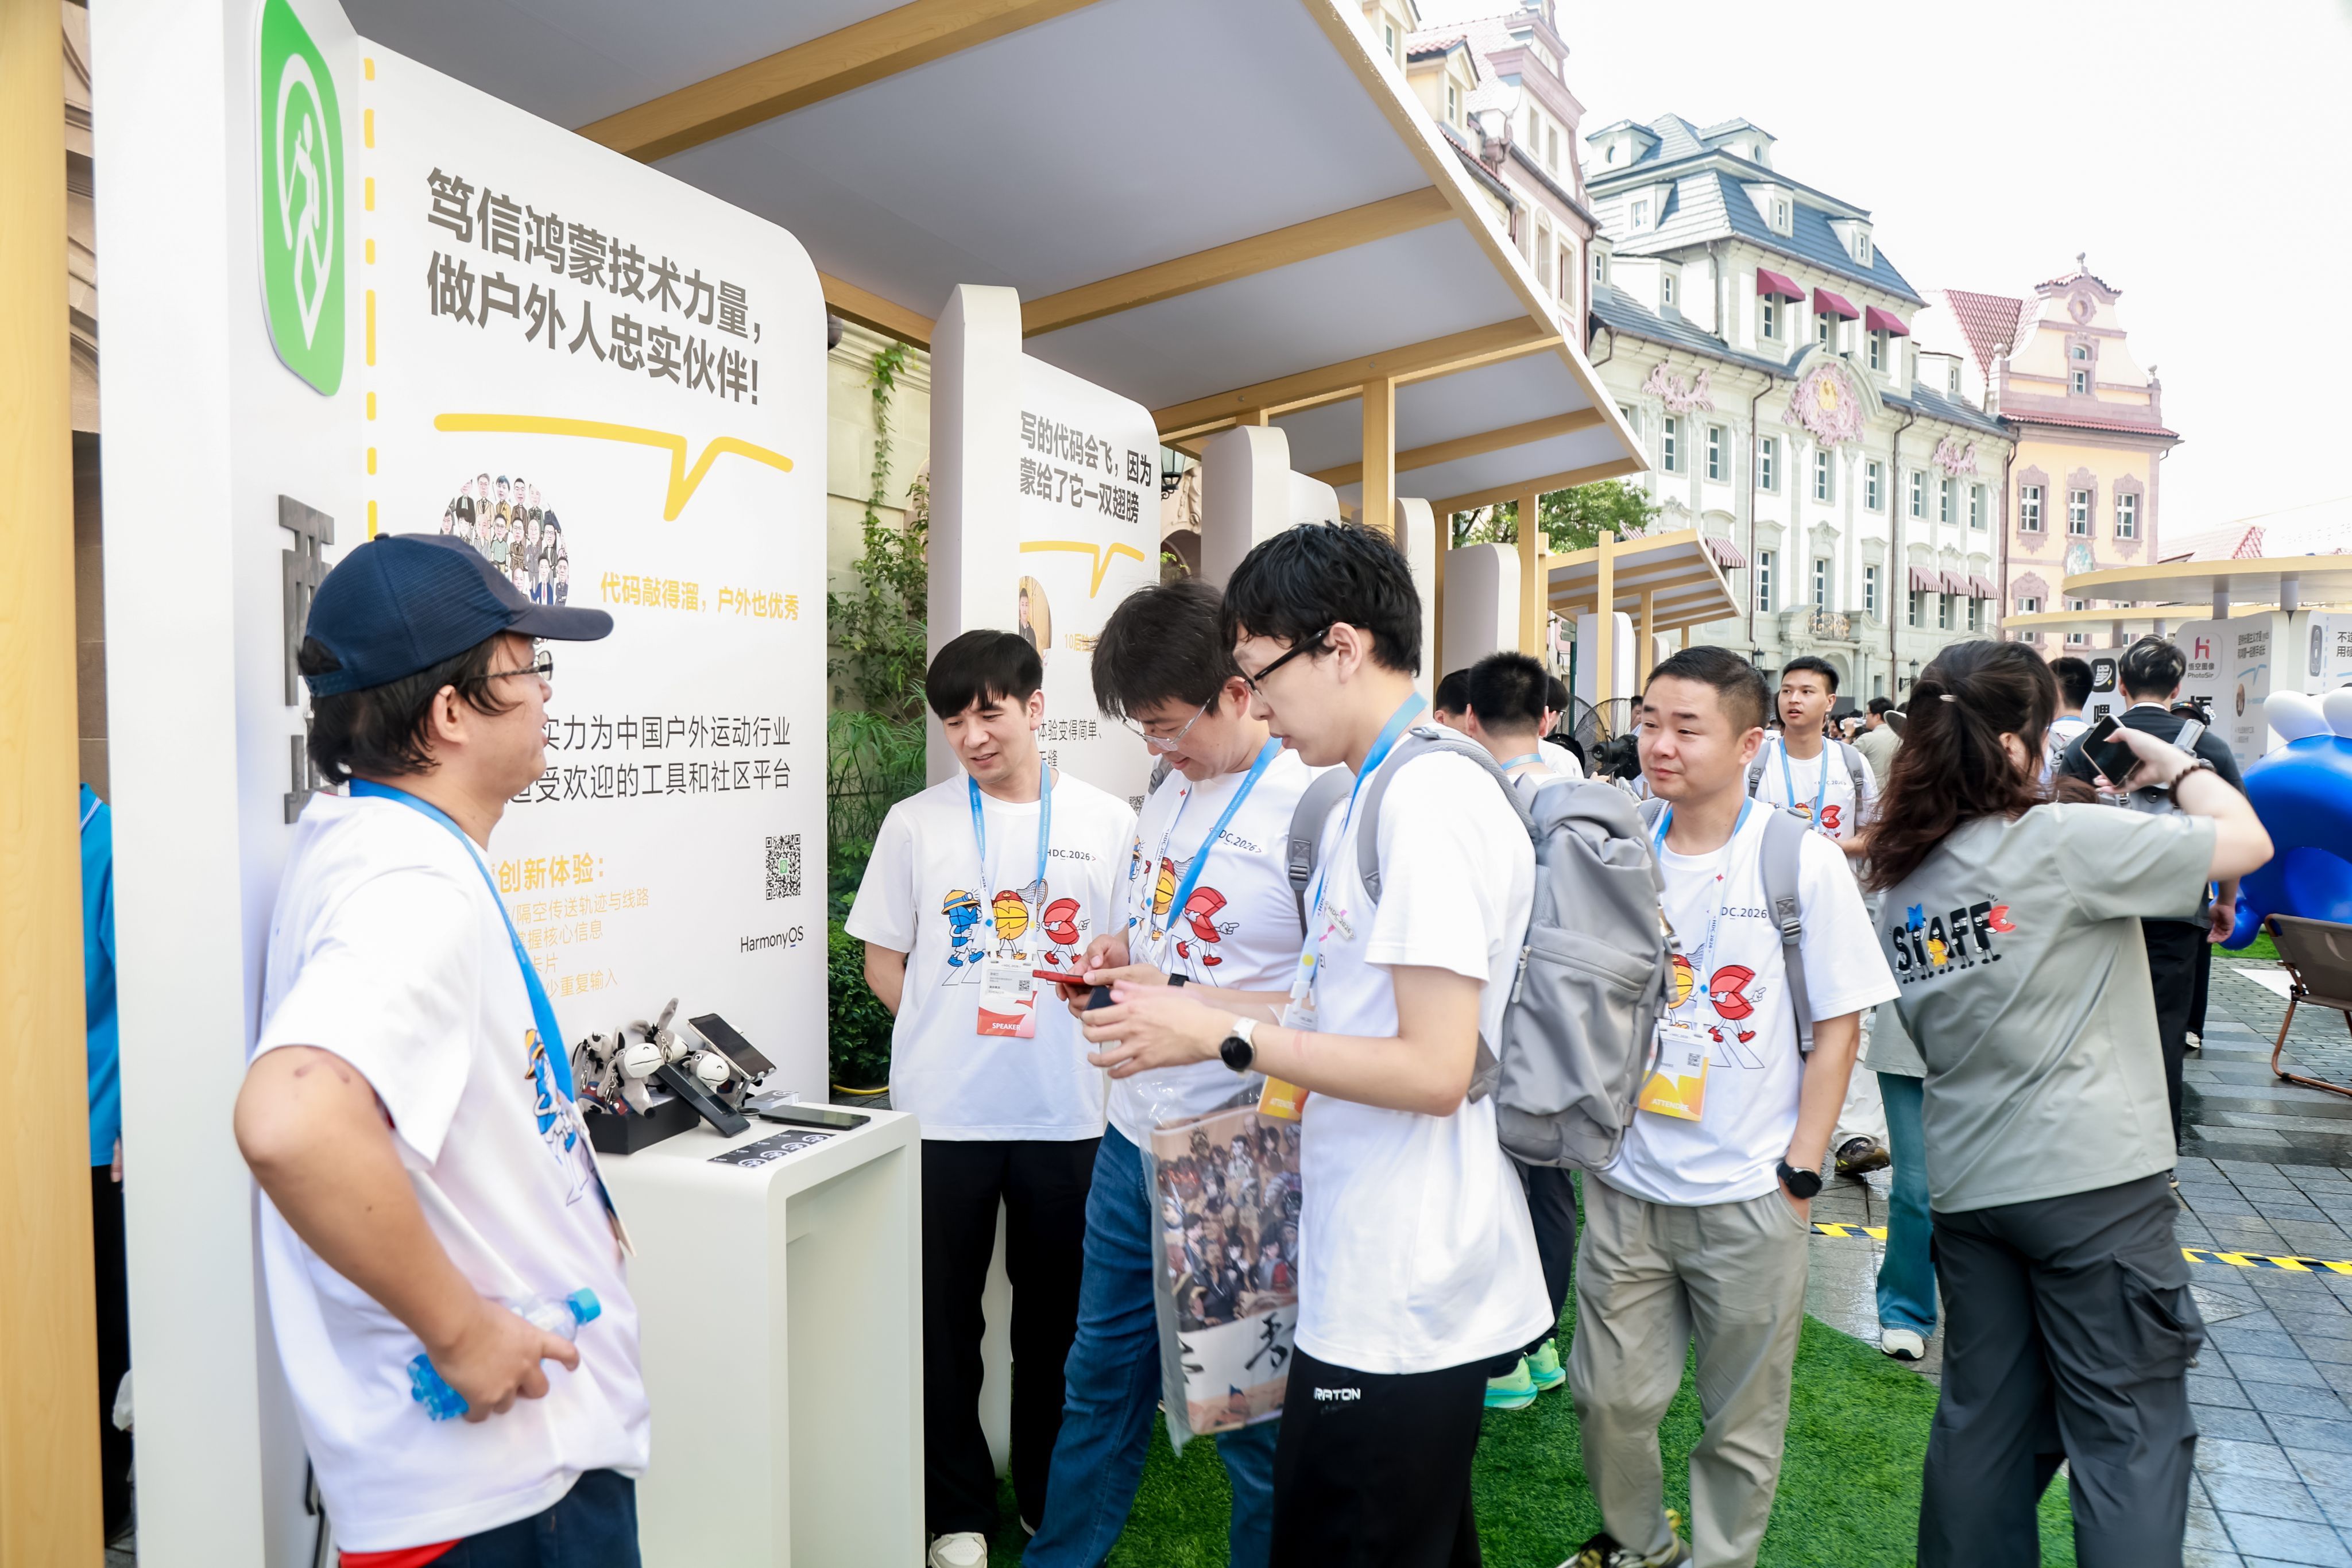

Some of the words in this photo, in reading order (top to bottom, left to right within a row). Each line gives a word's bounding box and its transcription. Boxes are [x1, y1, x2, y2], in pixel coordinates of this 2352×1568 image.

[427, 167, 761, 345] 笃信鸿蒙技术力量，
[427, 251, 759, 405] 做户外人忠实伙伴！
[600, 571, 799, 621] 代码敲得溜，户外也优秀
[491, 852, 604, 894] 创新体验：
[505, 887, 649, 926] /隔空传送轨迹与线路
[741, 926, 803, 953] HarmonyOS
[992, 1023, 1020, 1031] SPEAKER
[1651, 1098, 1689, 1112] ATTENDEE
[1313, 1387, 1361, 1401] RATON
